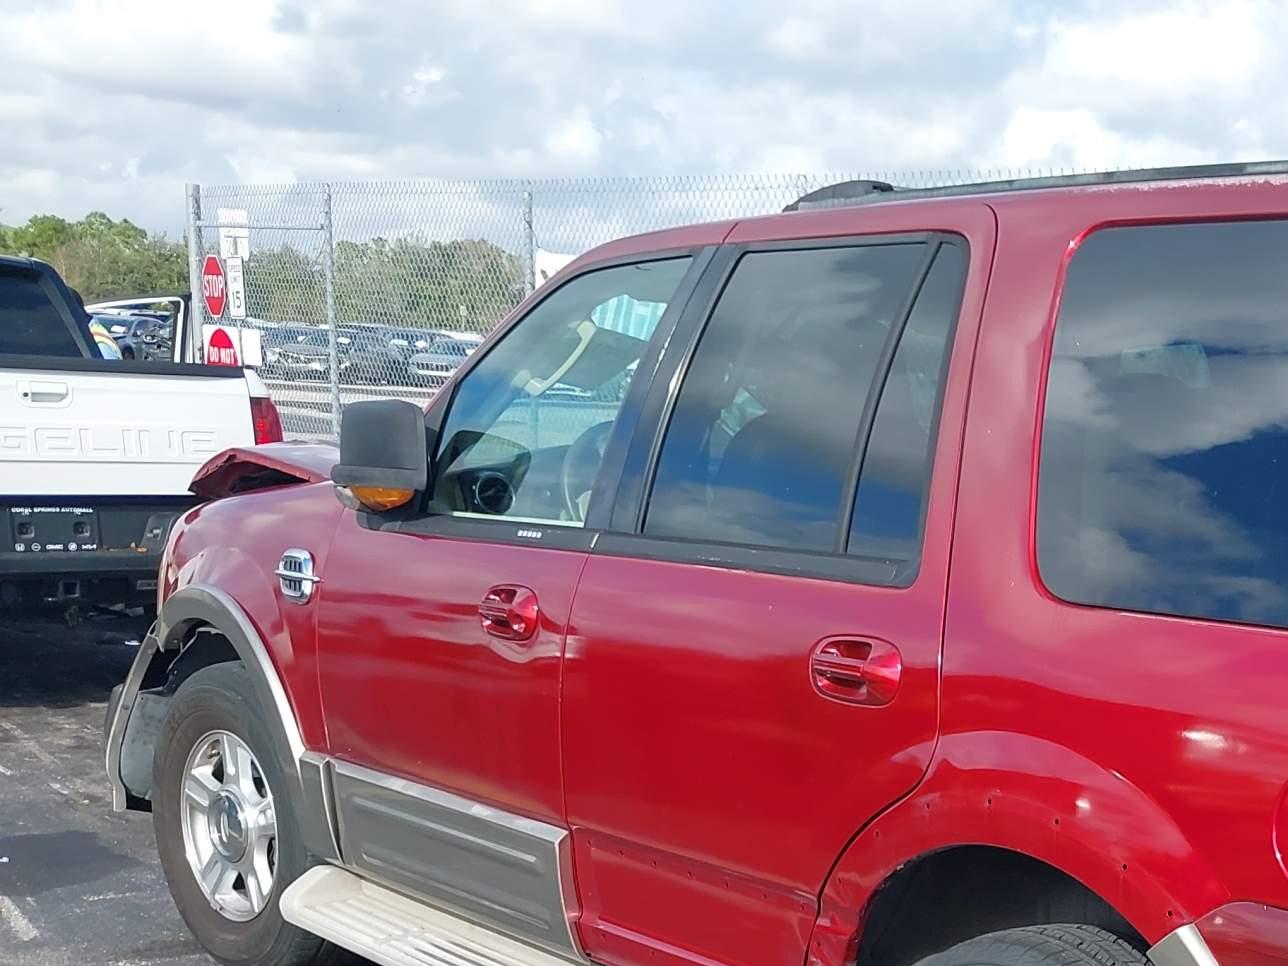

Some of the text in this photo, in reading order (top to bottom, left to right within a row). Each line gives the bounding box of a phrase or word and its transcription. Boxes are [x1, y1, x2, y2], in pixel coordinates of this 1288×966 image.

[204, 275, 223, 298] STOP
[232, 291, 241, 308] 15
[209, 346, 236, 364] DO NOT
